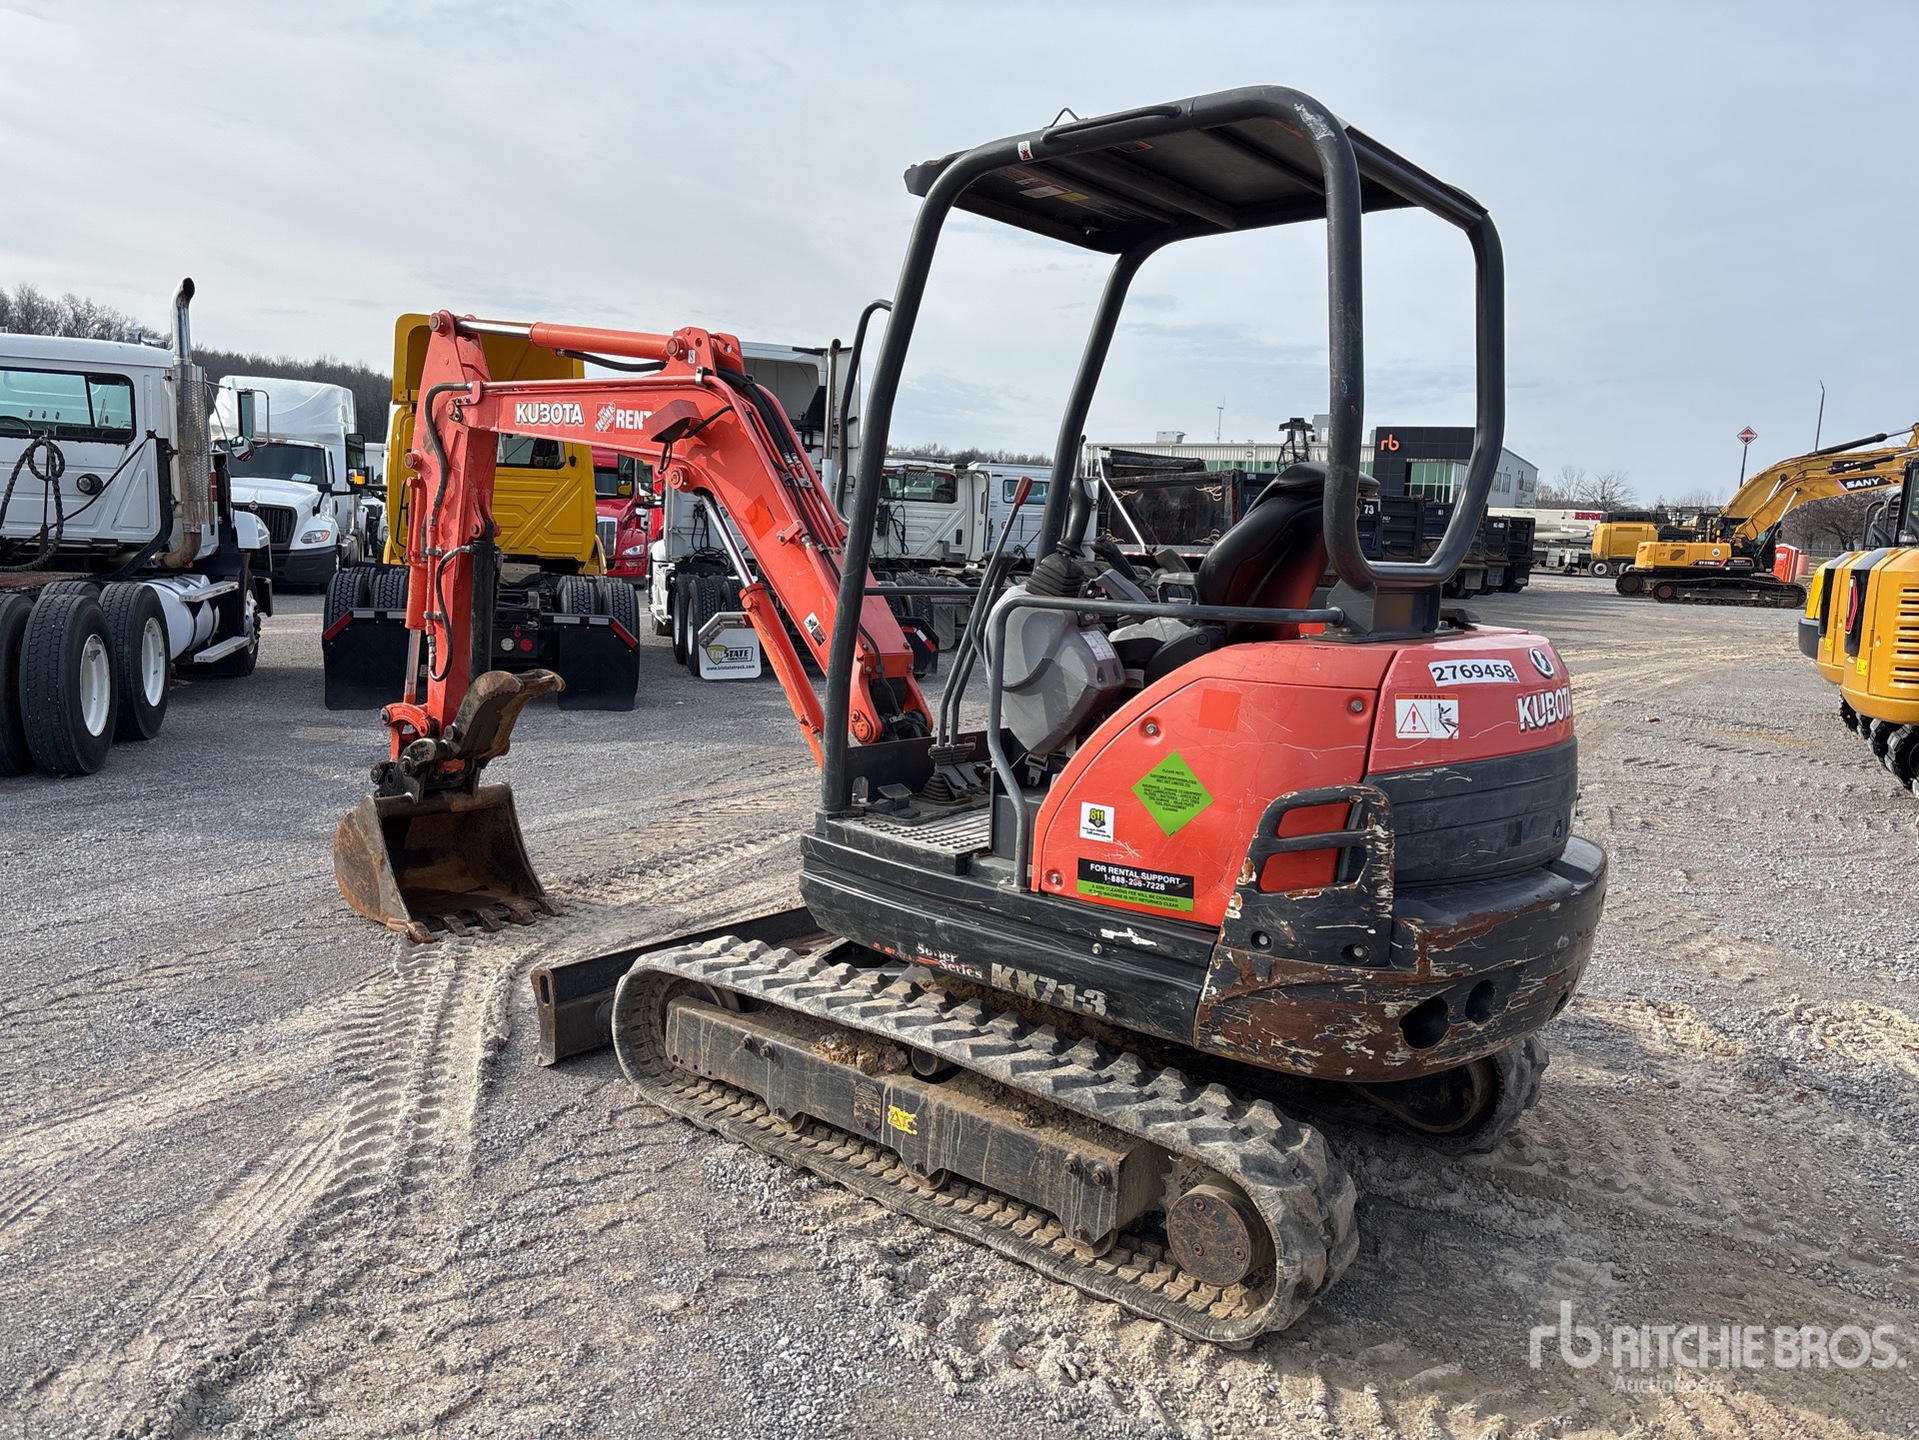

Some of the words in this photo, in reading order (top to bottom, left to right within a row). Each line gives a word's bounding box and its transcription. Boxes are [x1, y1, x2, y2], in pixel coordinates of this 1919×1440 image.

[516, 403, 584, 424] KUBOTA
[1380, 434, 1400, 451] rb
[1846, 478, 1880, 489] SANY
[1364, 504, 1374, 515] 73
[724, 649, 749, 658] STATE
[1432, 664, 1515, 682] 2769458
[1090, 809, 1105, 822] 811
[1090, 863, 1107, 873] FOR
[1108, 866, 1139, 879] RENTAL
[1140, 871, 1181, 885] SUPPORT
[939, 959, 983, 979] Series
[991, 962, 1107, 1017] KX71-3
